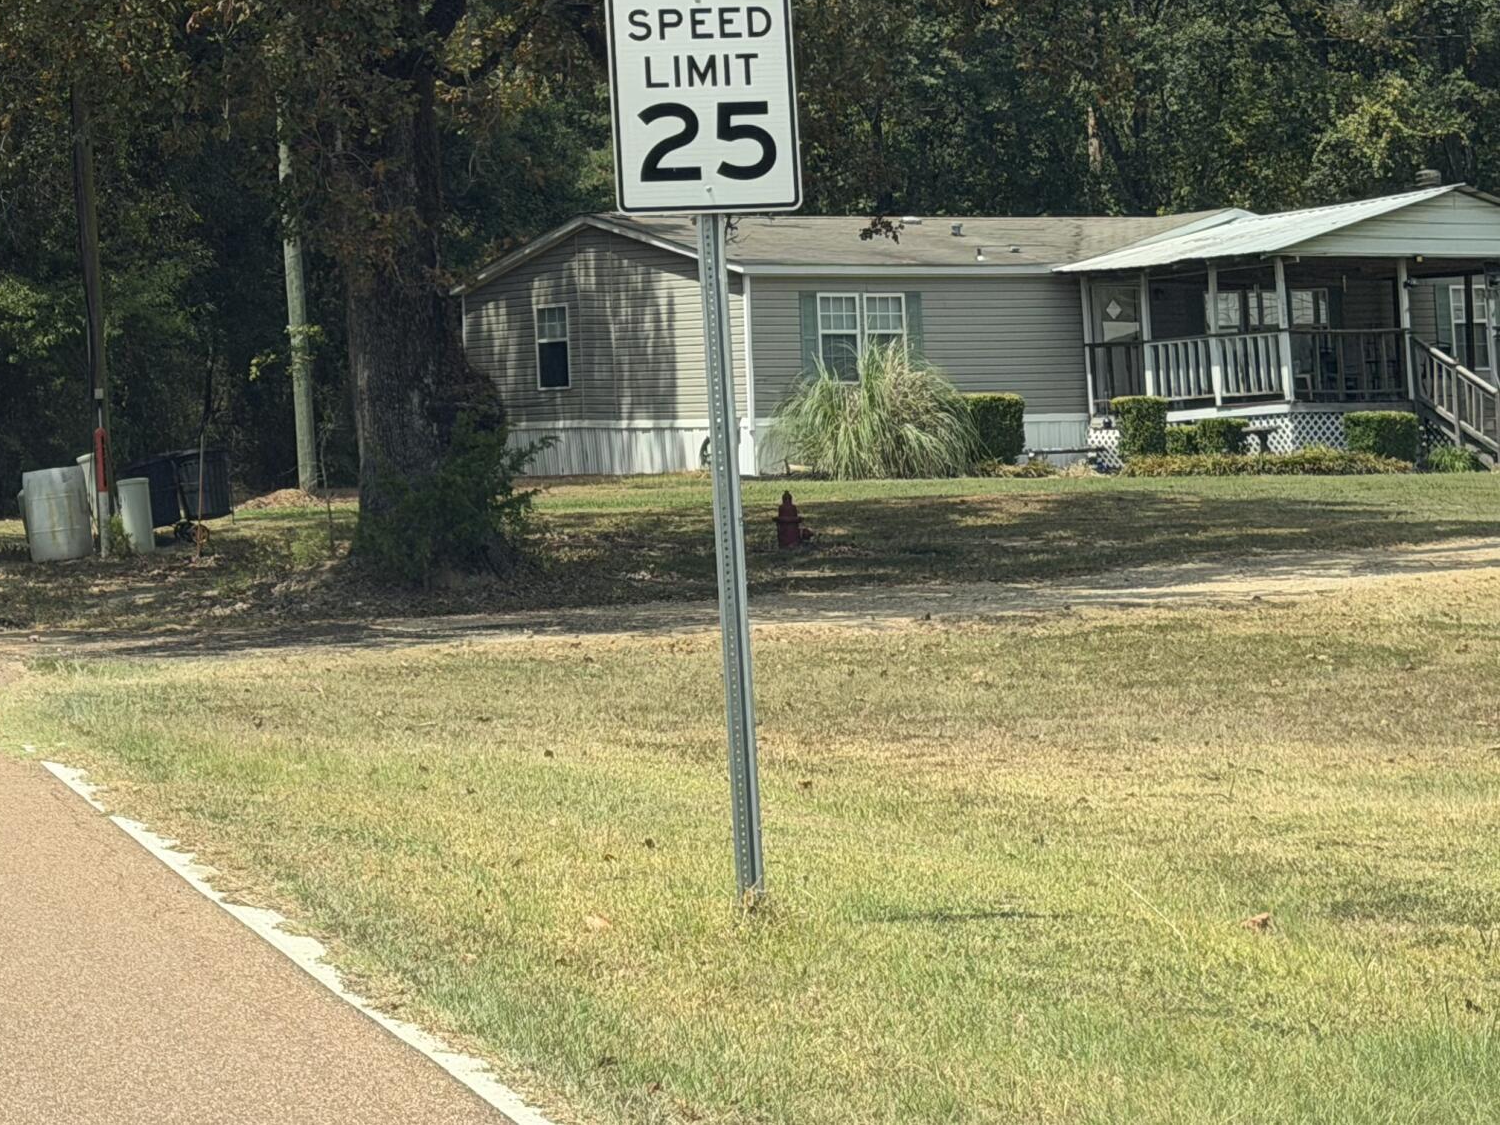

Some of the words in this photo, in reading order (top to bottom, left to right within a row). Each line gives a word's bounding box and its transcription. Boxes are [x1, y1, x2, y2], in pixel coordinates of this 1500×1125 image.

[628, 7, 772, 41] SPEED
[644, 53, 758, 88] LIMIT
[637, 101, 777, 182] 25
